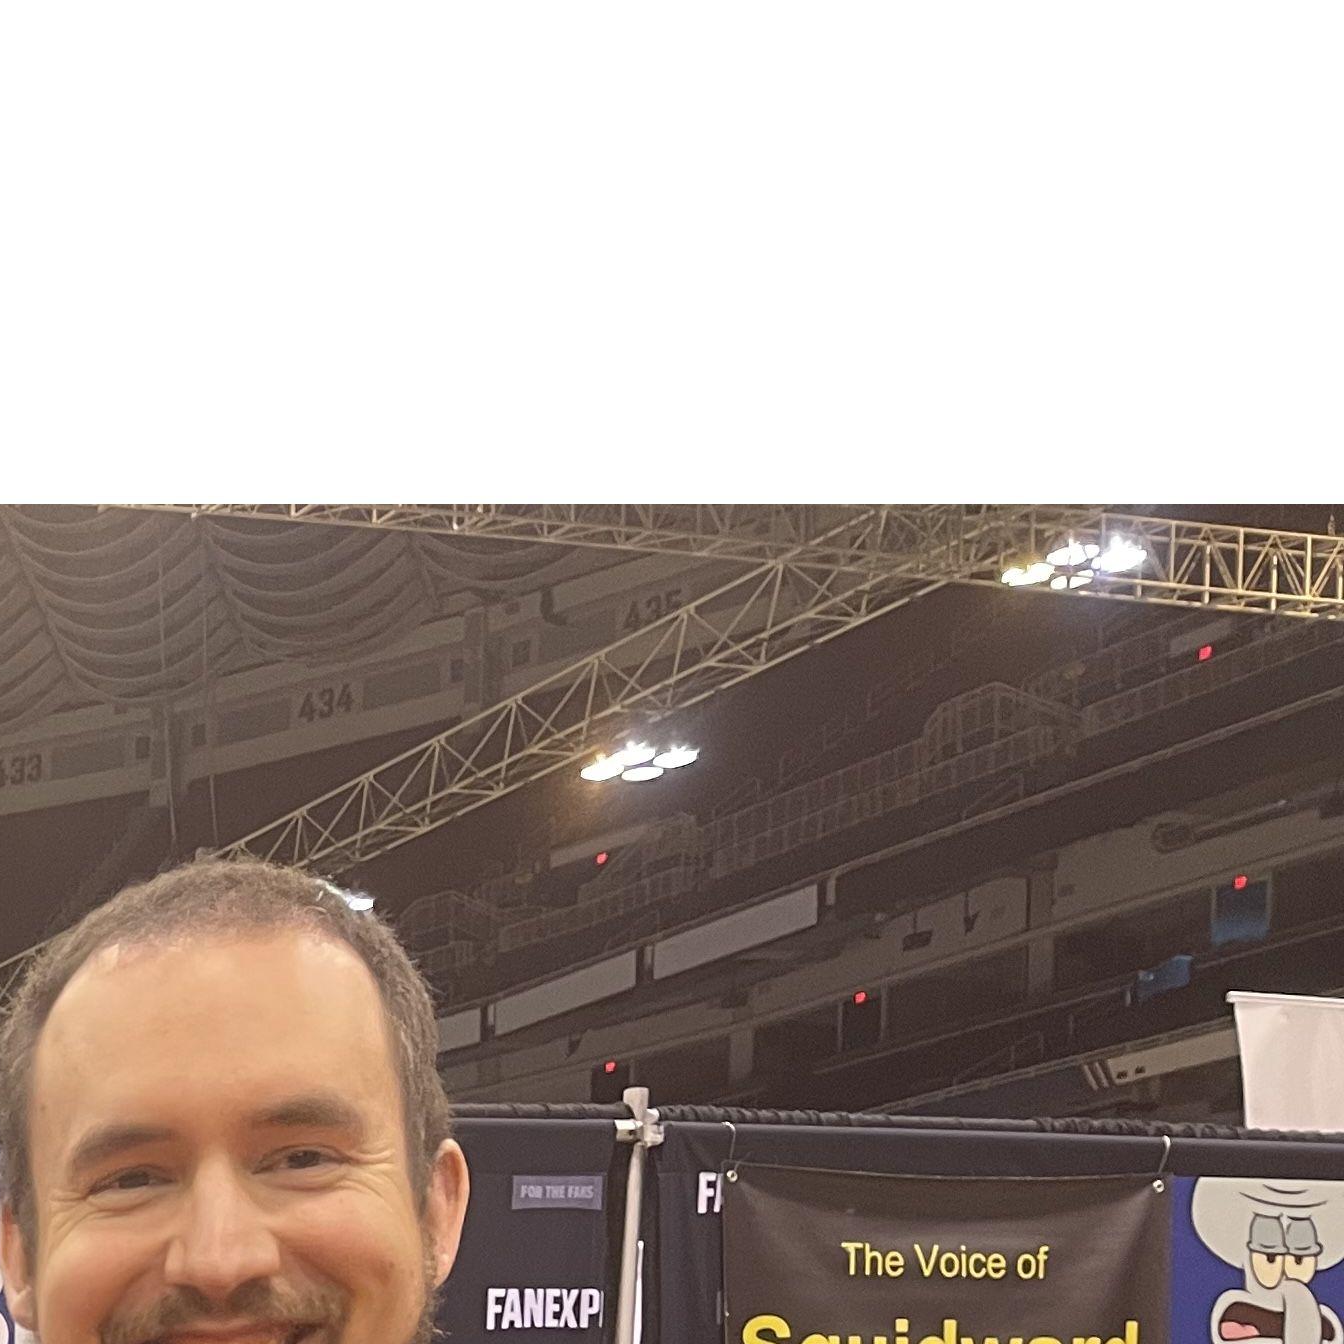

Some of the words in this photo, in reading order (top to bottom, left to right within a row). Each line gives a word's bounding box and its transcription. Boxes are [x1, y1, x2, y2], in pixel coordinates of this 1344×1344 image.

[296, 684, 354, 722] 434
[841, 1243, 904, 1277] The
[914, 1244, 1006, 1278] Voice
[1016, 1247, 1049, 1279] of
[486, 1288, 604, 1329] FANEXP
